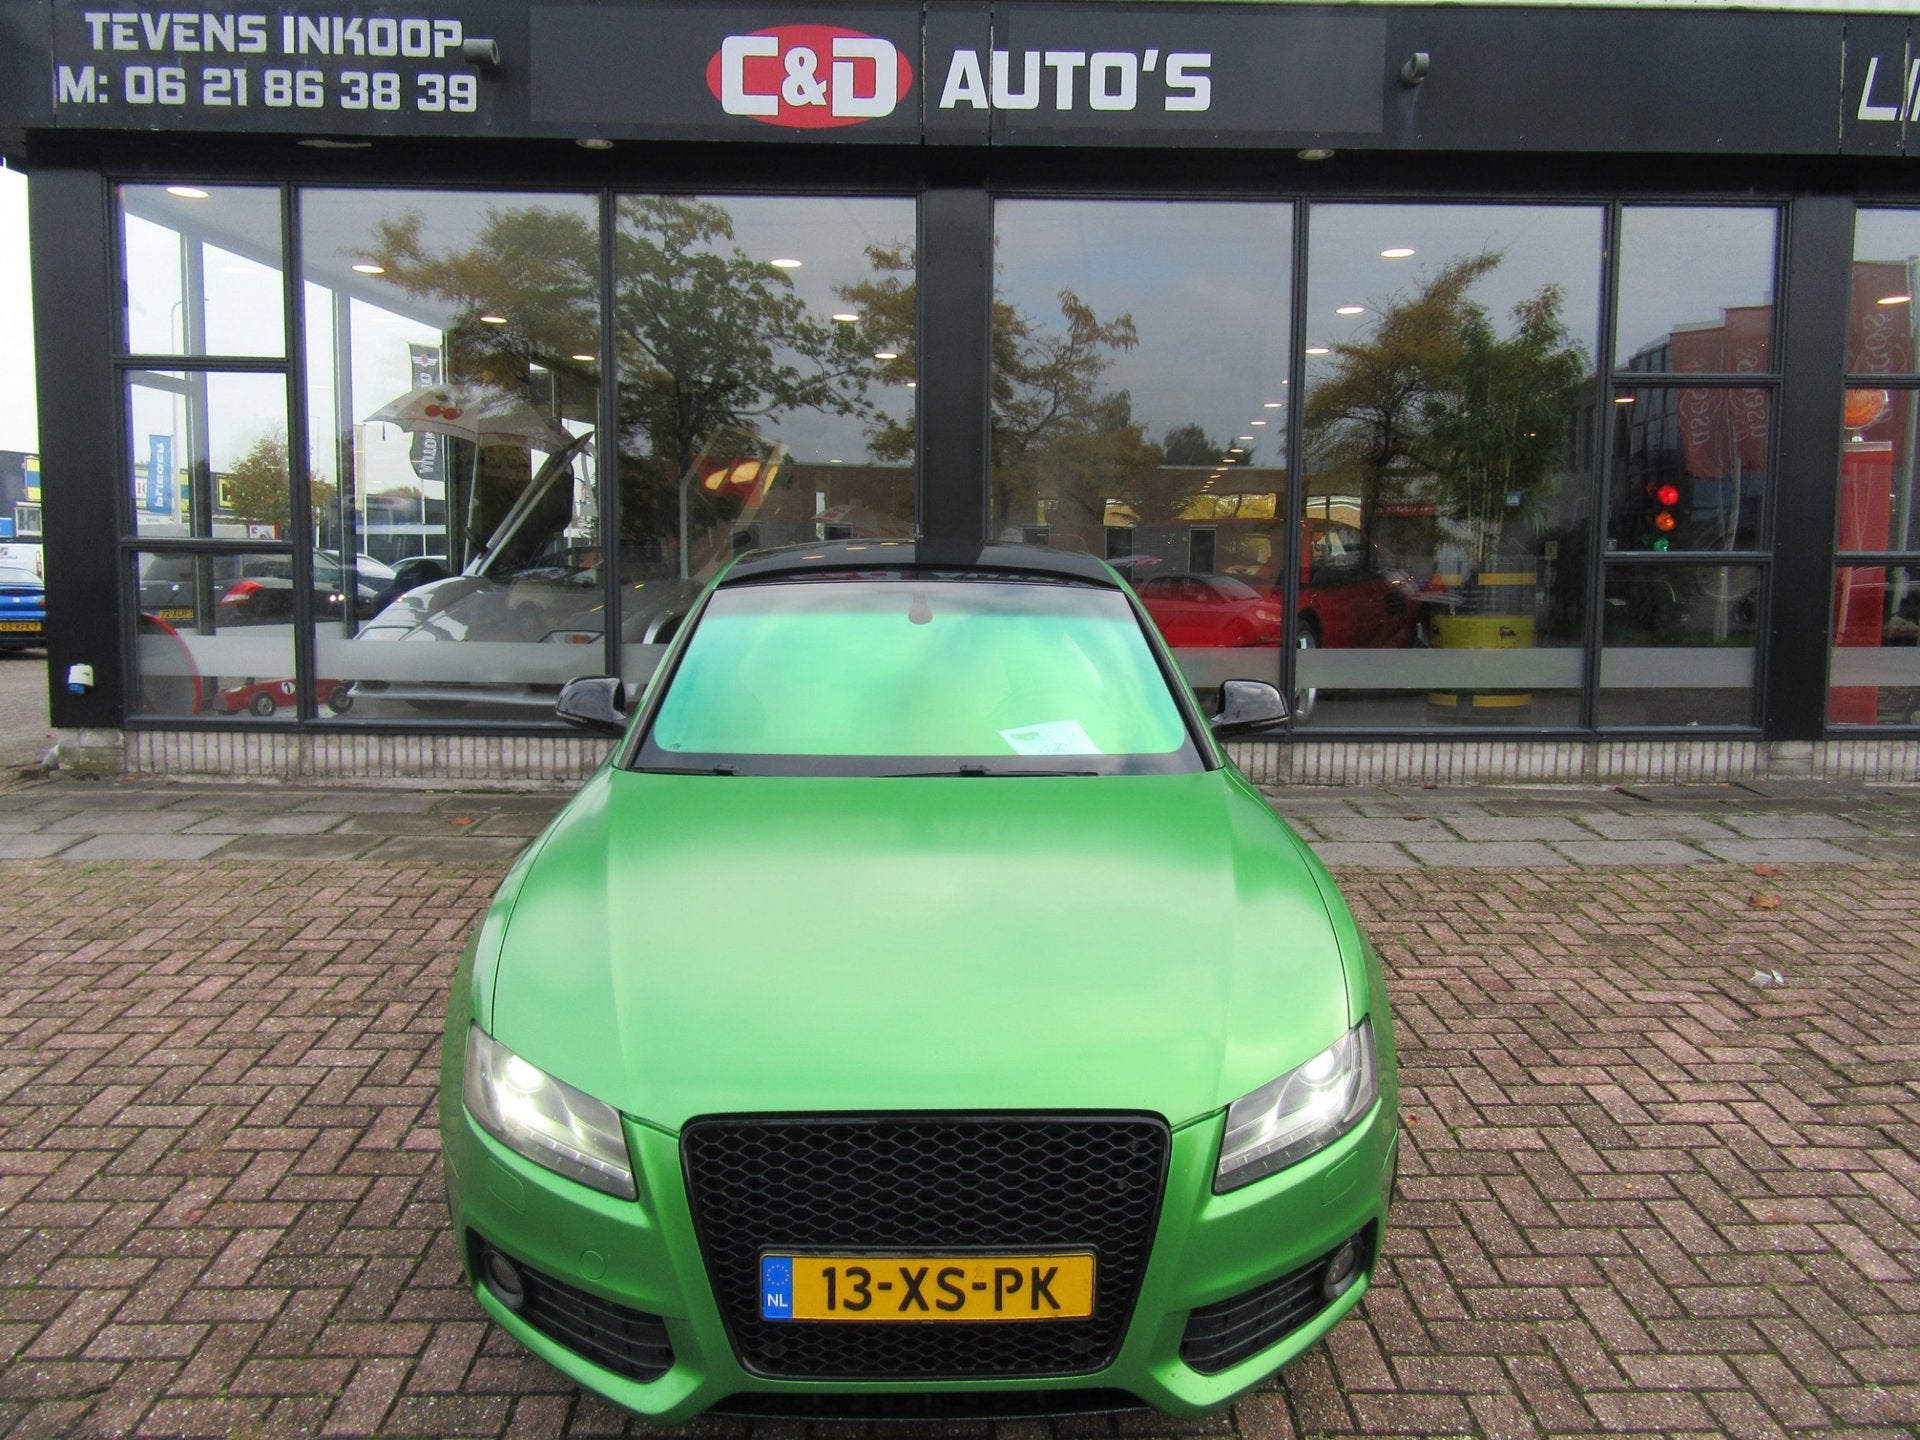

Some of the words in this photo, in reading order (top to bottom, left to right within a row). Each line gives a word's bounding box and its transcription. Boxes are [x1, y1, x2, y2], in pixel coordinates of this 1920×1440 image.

[85, 12, 267, 53] TEVENS
[283, 16, 462, 58] INKOOP
[58, 66, 108, 104] M:
[125, 66, 186, 105] 06
[203, 68, 248, 106] 21
[264, 69, 325, 108] 86
[340, 71, 401, 110] 38
[417, 73, 477, 112] 39
[721, 36, 898, 118] C&D
[939, 49, 1212, 111] AUTO'S
[767, 1293, 788, 1307] NL
[822, 1266, 1061, 1311] 13-XS-PK
